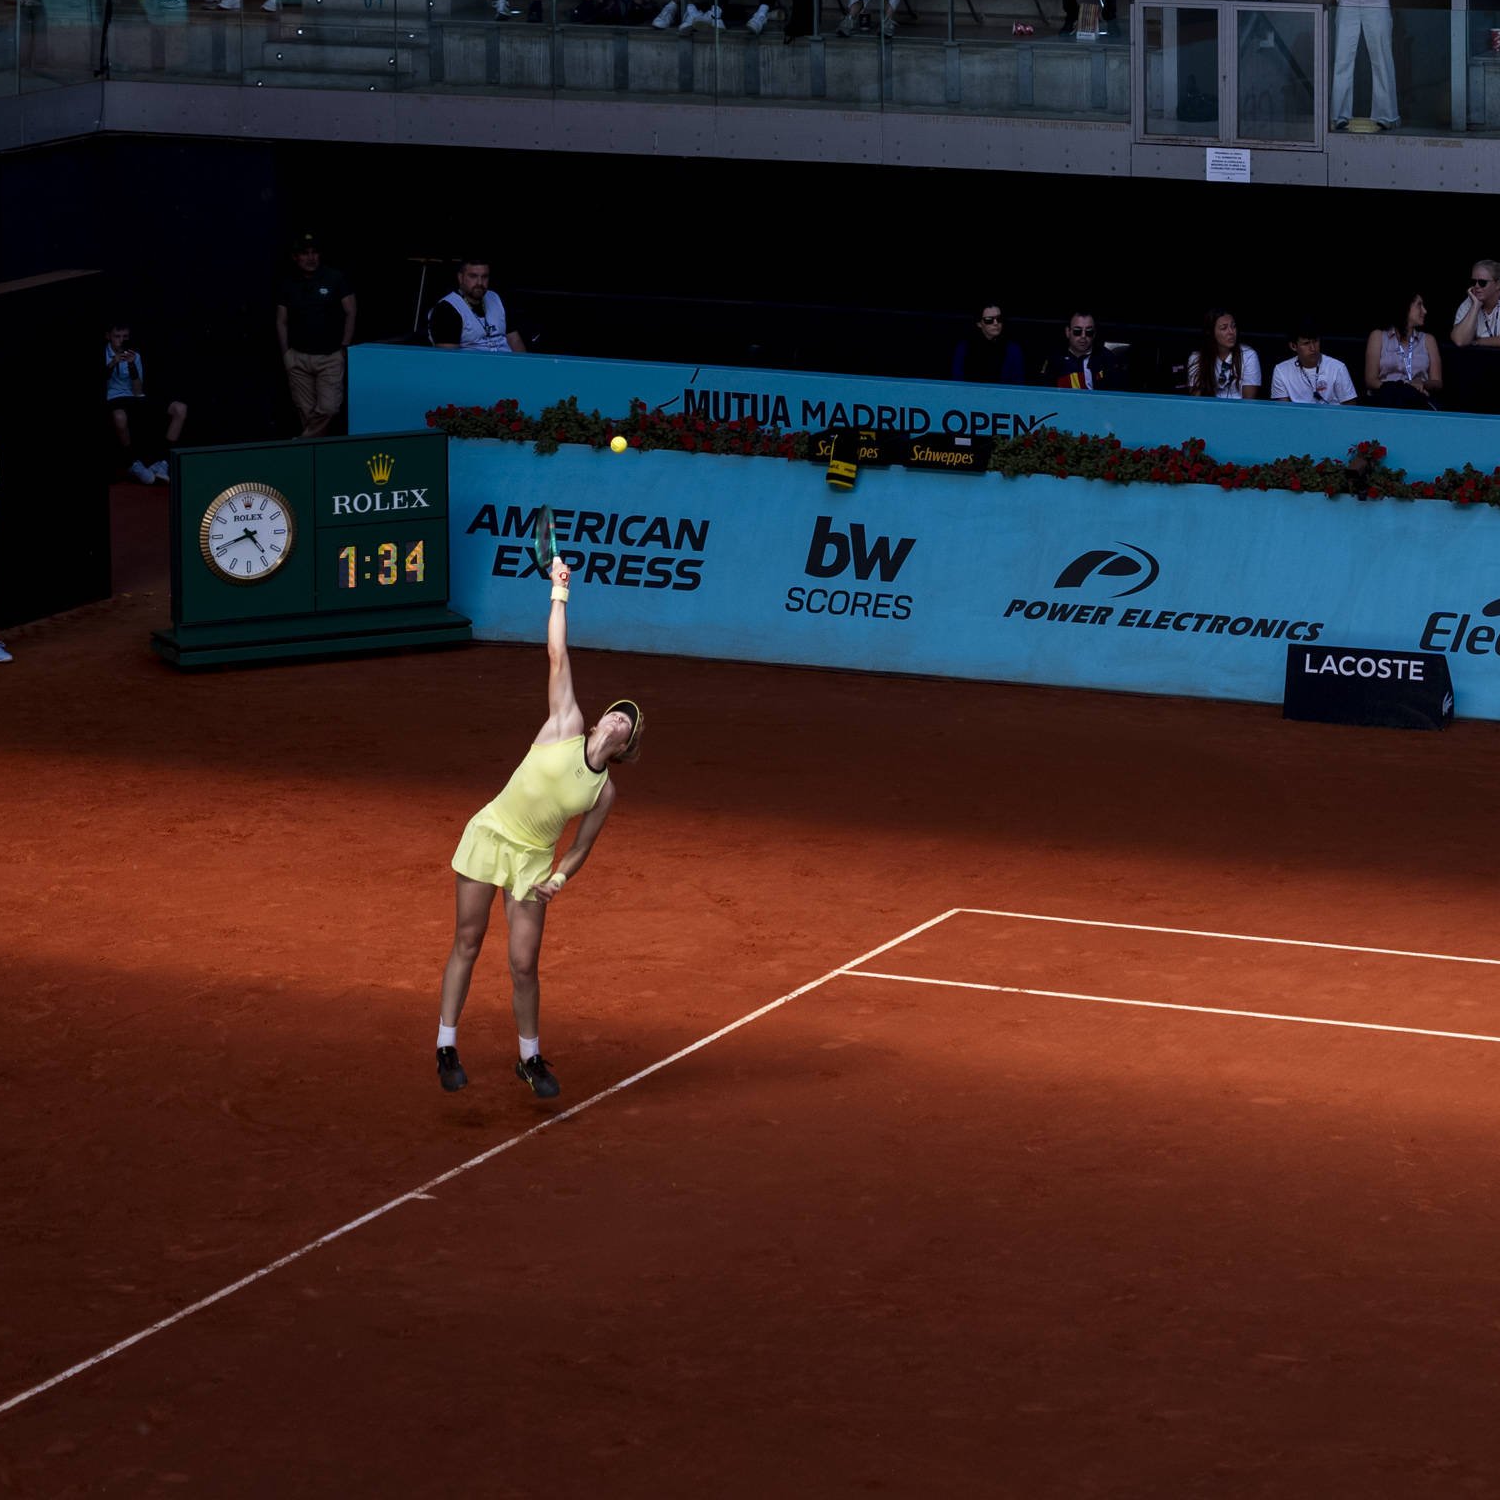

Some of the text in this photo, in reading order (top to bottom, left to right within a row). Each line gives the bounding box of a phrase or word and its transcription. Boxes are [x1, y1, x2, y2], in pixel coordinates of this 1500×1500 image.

[683, 389, 1036, 438] MUTUA MADRID OPEN
[911, 444, 975, 466] Schweppes
[233, 513, 263, 522] ROLEX
[332, 487, 431, 516] ROLEX
[465, 503, 710, 552] AMERICAN
[339, 539, 426, 589] 1:34
[492, 544, 706, 592] EXPRESS
[785, 586, 913, 621] SCORES
[1002, 598, 1324, 642] POWER ELECTRONICS
[1303, 651, 1425, 682] LACOSTE
